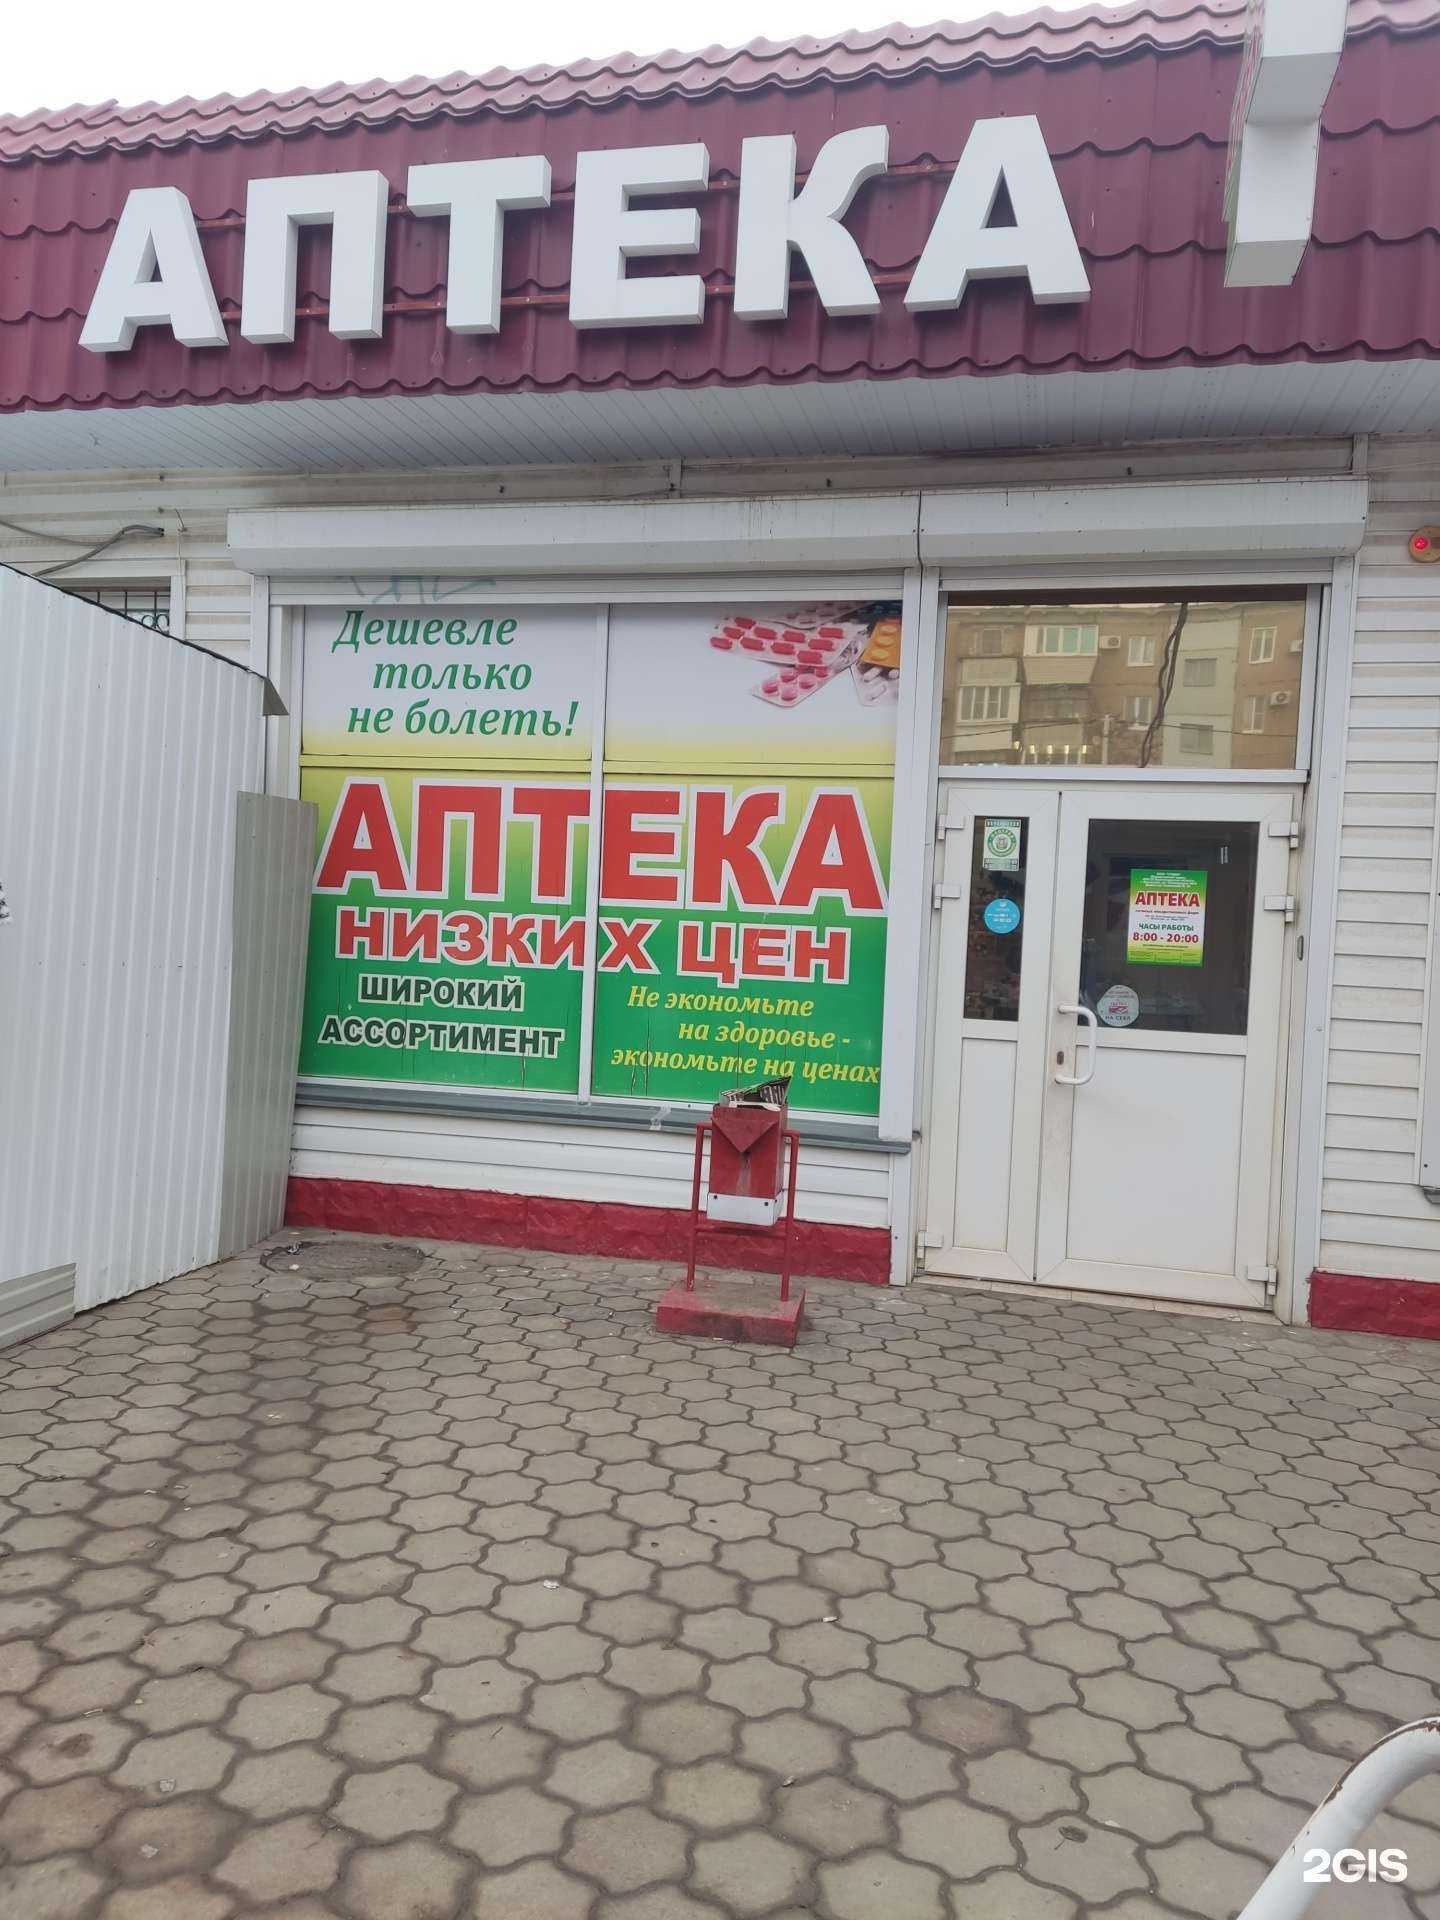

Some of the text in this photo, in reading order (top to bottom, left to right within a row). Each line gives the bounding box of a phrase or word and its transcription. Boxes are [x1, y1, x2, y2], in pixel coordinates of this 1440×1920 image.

[78, 113, 1092, 354] АПТЕКА
[331, 609, 519, 653] Дешевле
[372, 662, 533, 690] только
[346, 697, 580, 737] не болеть!
[313, 778, 888, 916] АПТЕКА
[1135, 891, 1200, 907] АПТЕКА
[1132, 932, 1158, 942] 8:00
[1166, 933, 1199, 944] 20:00
[1138, 923, 1194, 932] ЧАСЫ РАБОТЫ
[336, 906, 851, 988] НИЗКИХ ЦЕН
[359, 974, 524, 1011] ШИРОКИЙ
[627, 985, 815, 1017] Не экономьте
[320, 1015, 565, 1058] АССОРТИМЕНТ
[678, 1022, 710, 1041] на
[715, 1020, 836, 1051] здоровье
[611, 1048, 880, 1084] экономьте на ценах
